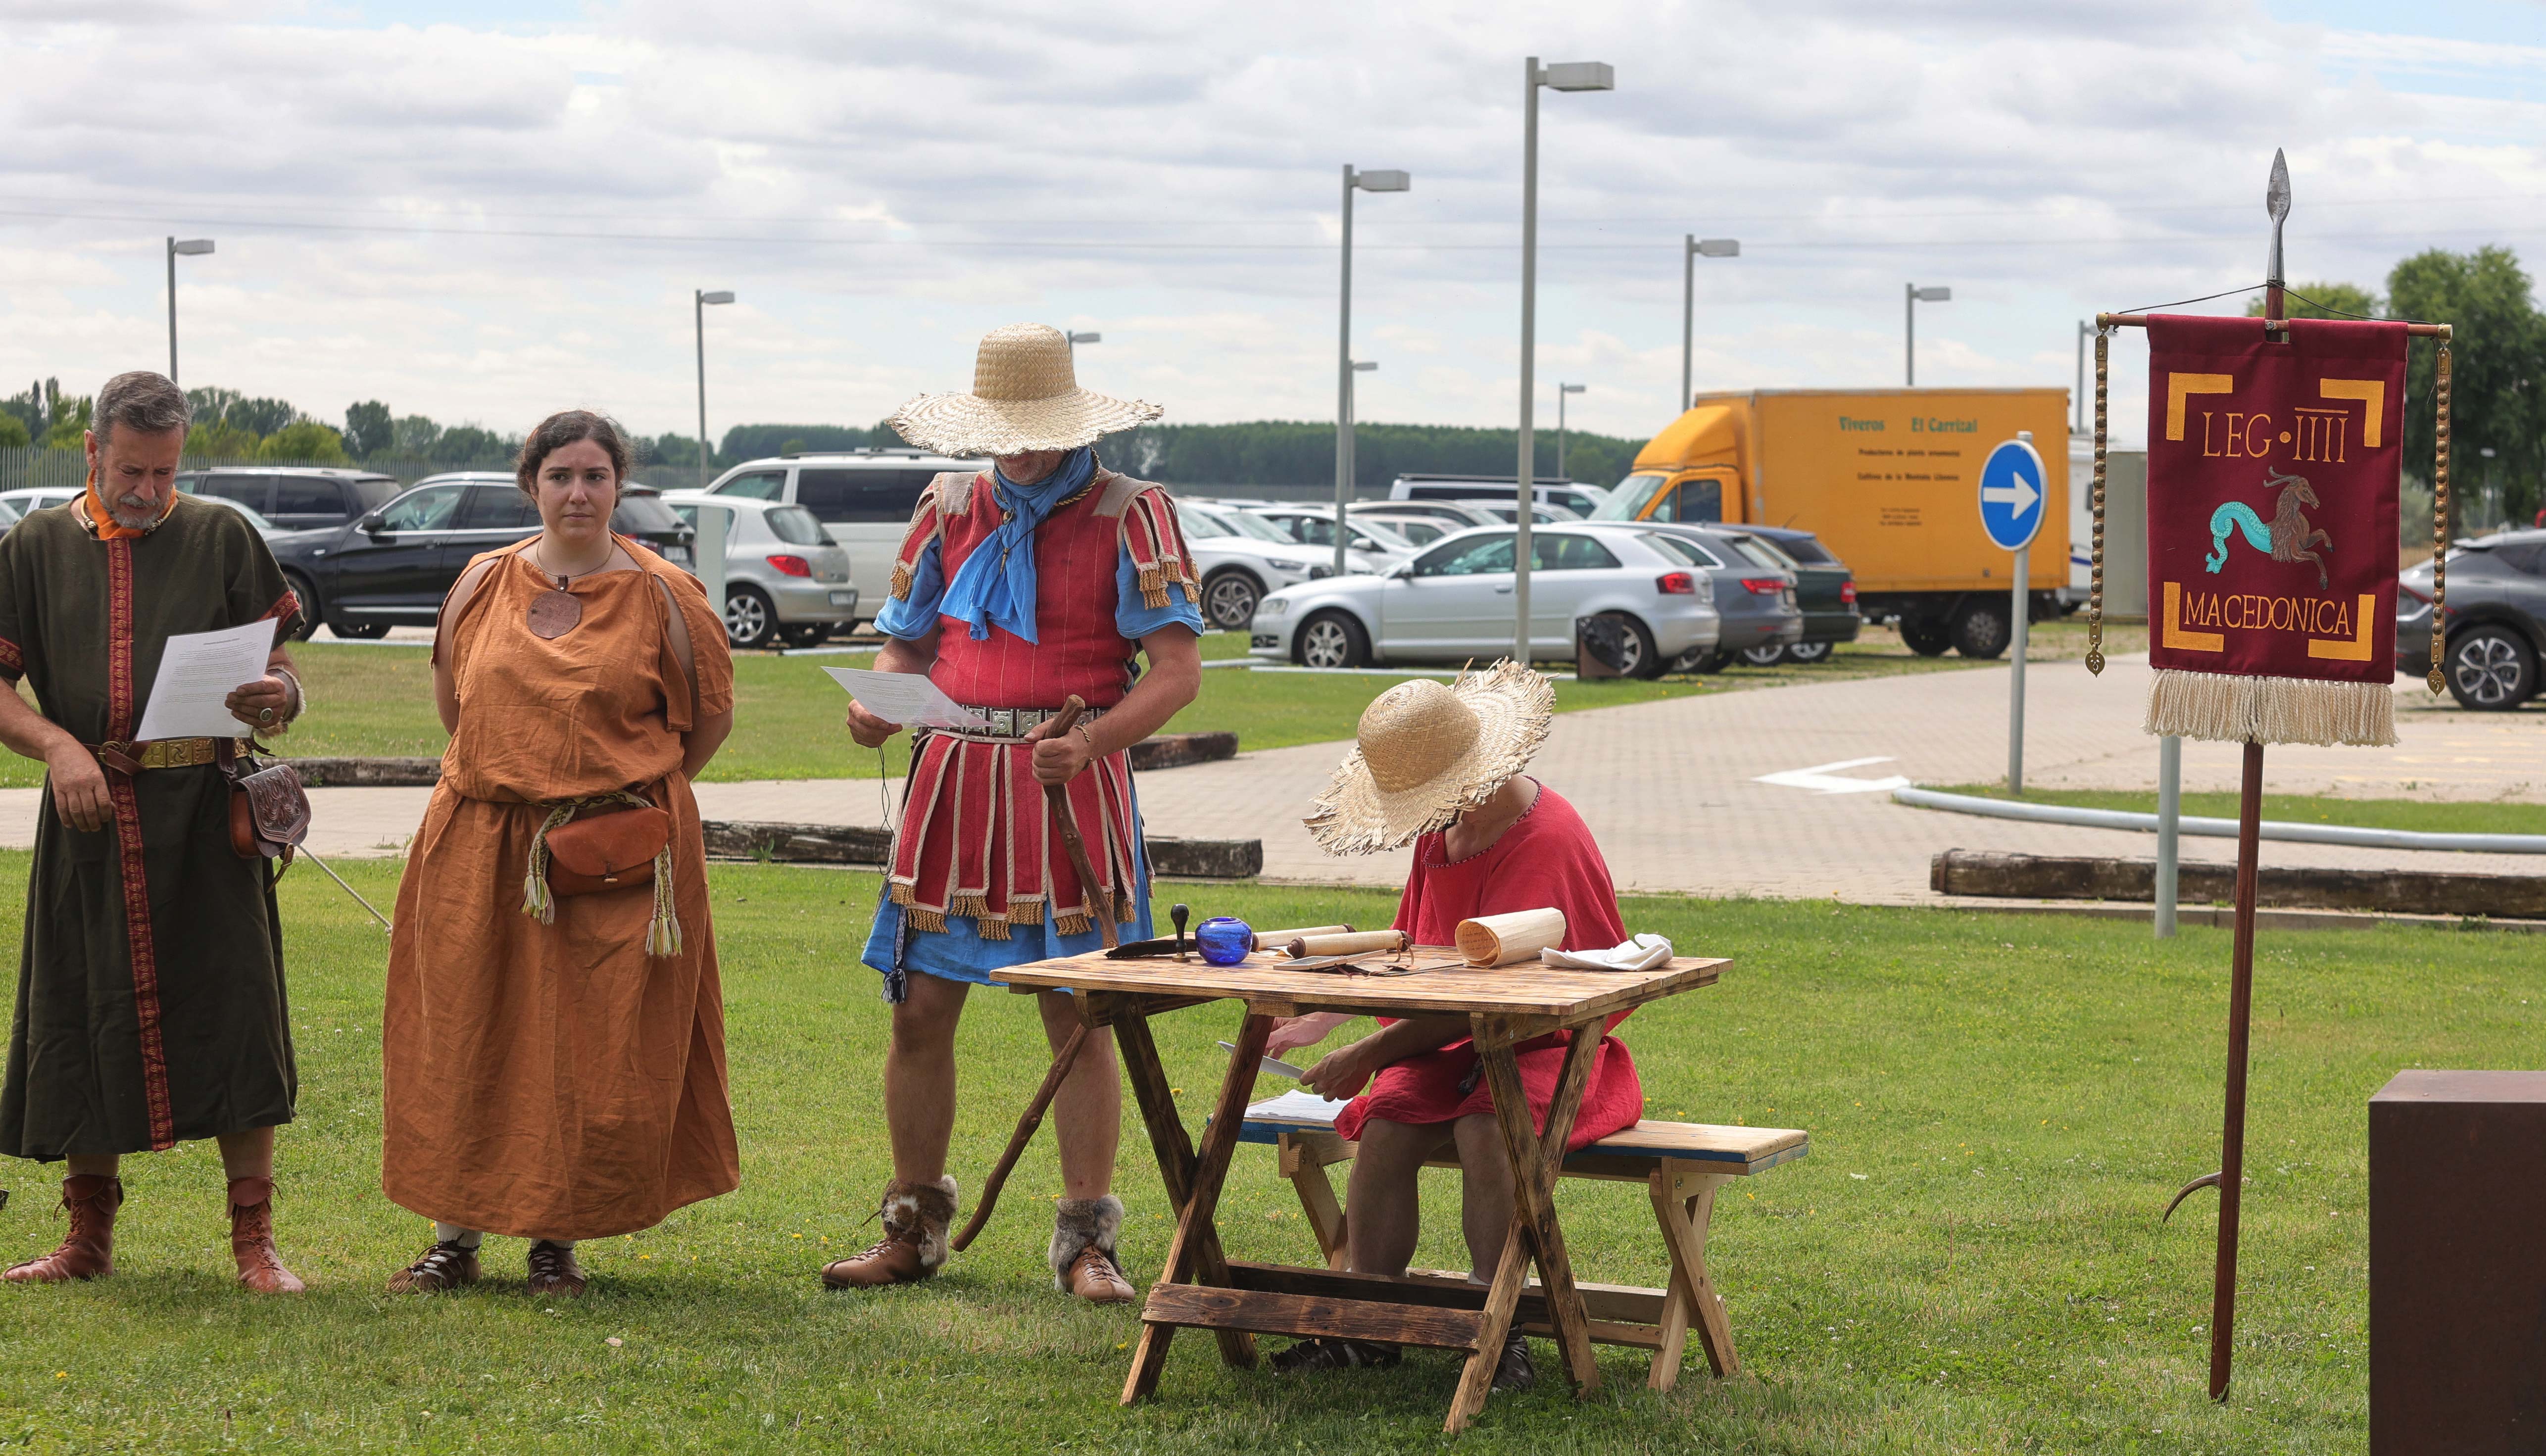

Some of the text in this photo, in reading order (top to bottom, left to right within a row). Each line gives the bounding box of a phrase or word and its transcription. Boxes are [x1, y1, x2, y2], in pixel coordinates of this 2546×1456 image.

[1838, 416, 1885, 431] Viveros
[1911, 417, 1924, 433] El
[2184, 591, 2352, 635] MACEDONICA
